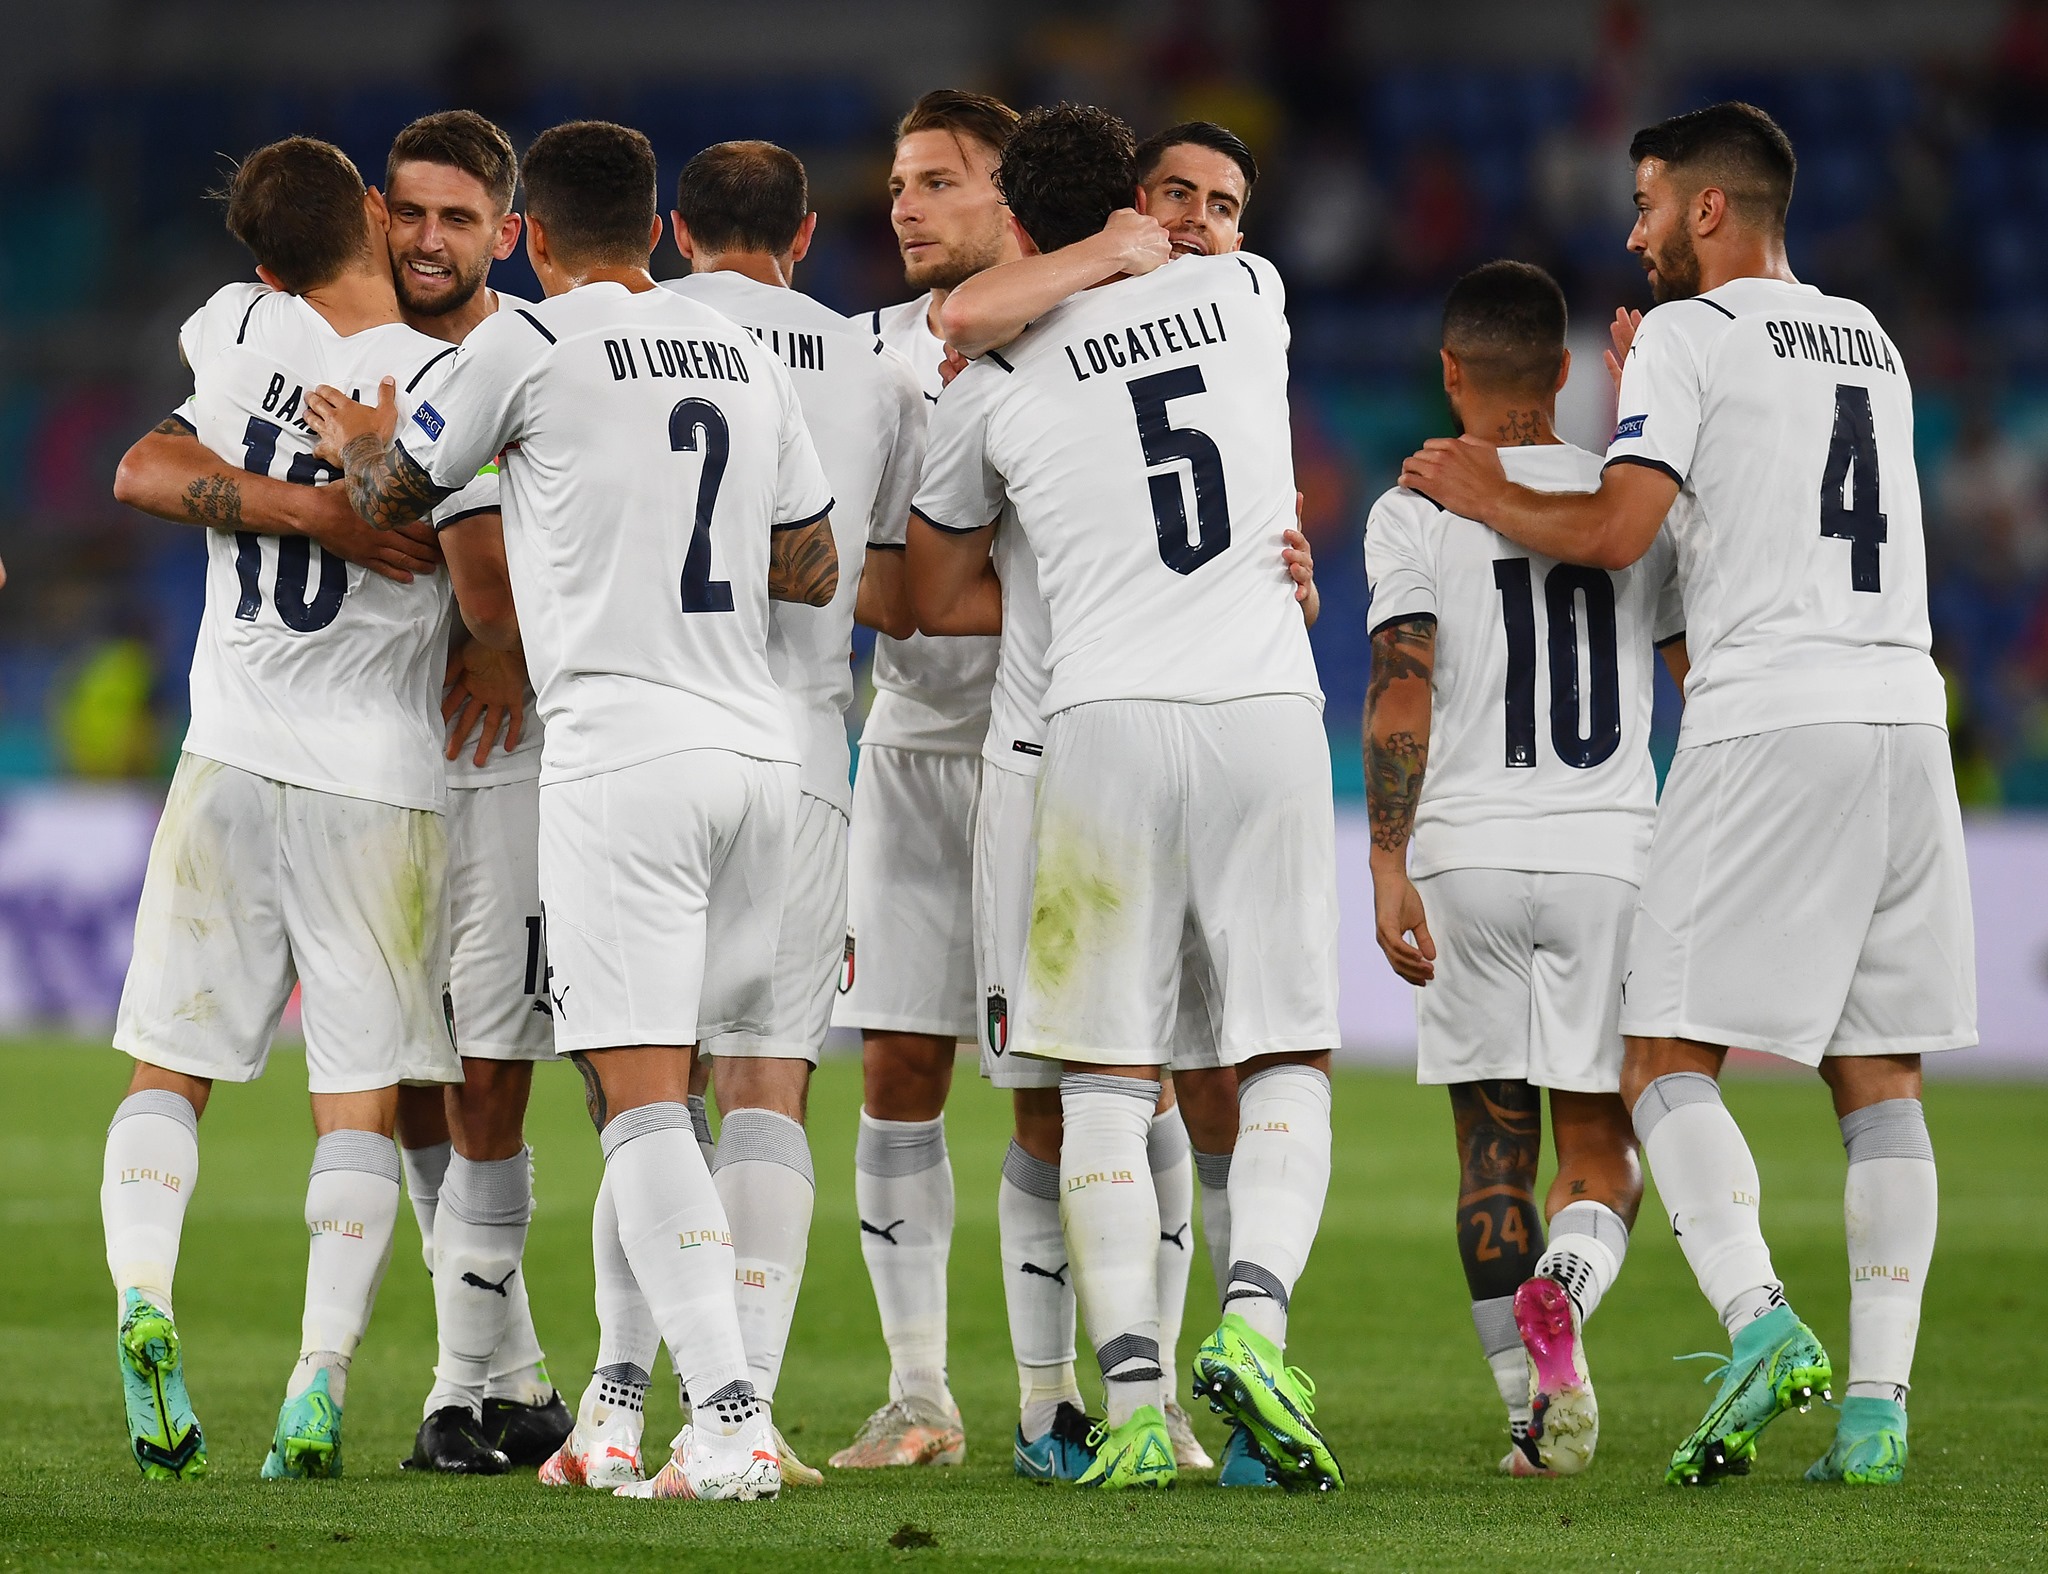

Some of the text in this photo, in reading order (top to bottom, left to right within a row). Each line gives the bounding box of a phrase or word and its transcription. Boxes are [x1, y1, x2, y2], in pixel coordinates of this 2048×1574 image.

[604, 338, 750, 384] DI LORENZO
[1065, 303, 1227, 381] LOCATELLI
[1766, 320, 1896, 375] SPINAZZOLA
[417, 407, 442, 434] SPECT
[1127, 365, 1231, 575] 5
[1820, 383, 1887, 593] 4
[669, 397, 735, 613] 2
[1492, 557, 1621, 768] 10
[1244, 1121, 1288, 1134] ALIA
[121, 1168, 181, 1190] ITALIA
[1067, 1170, 1132, 1190] ITALIA
[307, 1220, 364, 1236] ITALIA
[1470, 1206, 1529, 1263] 24
[1855, 1265, 1909, 1280] ITALIA
